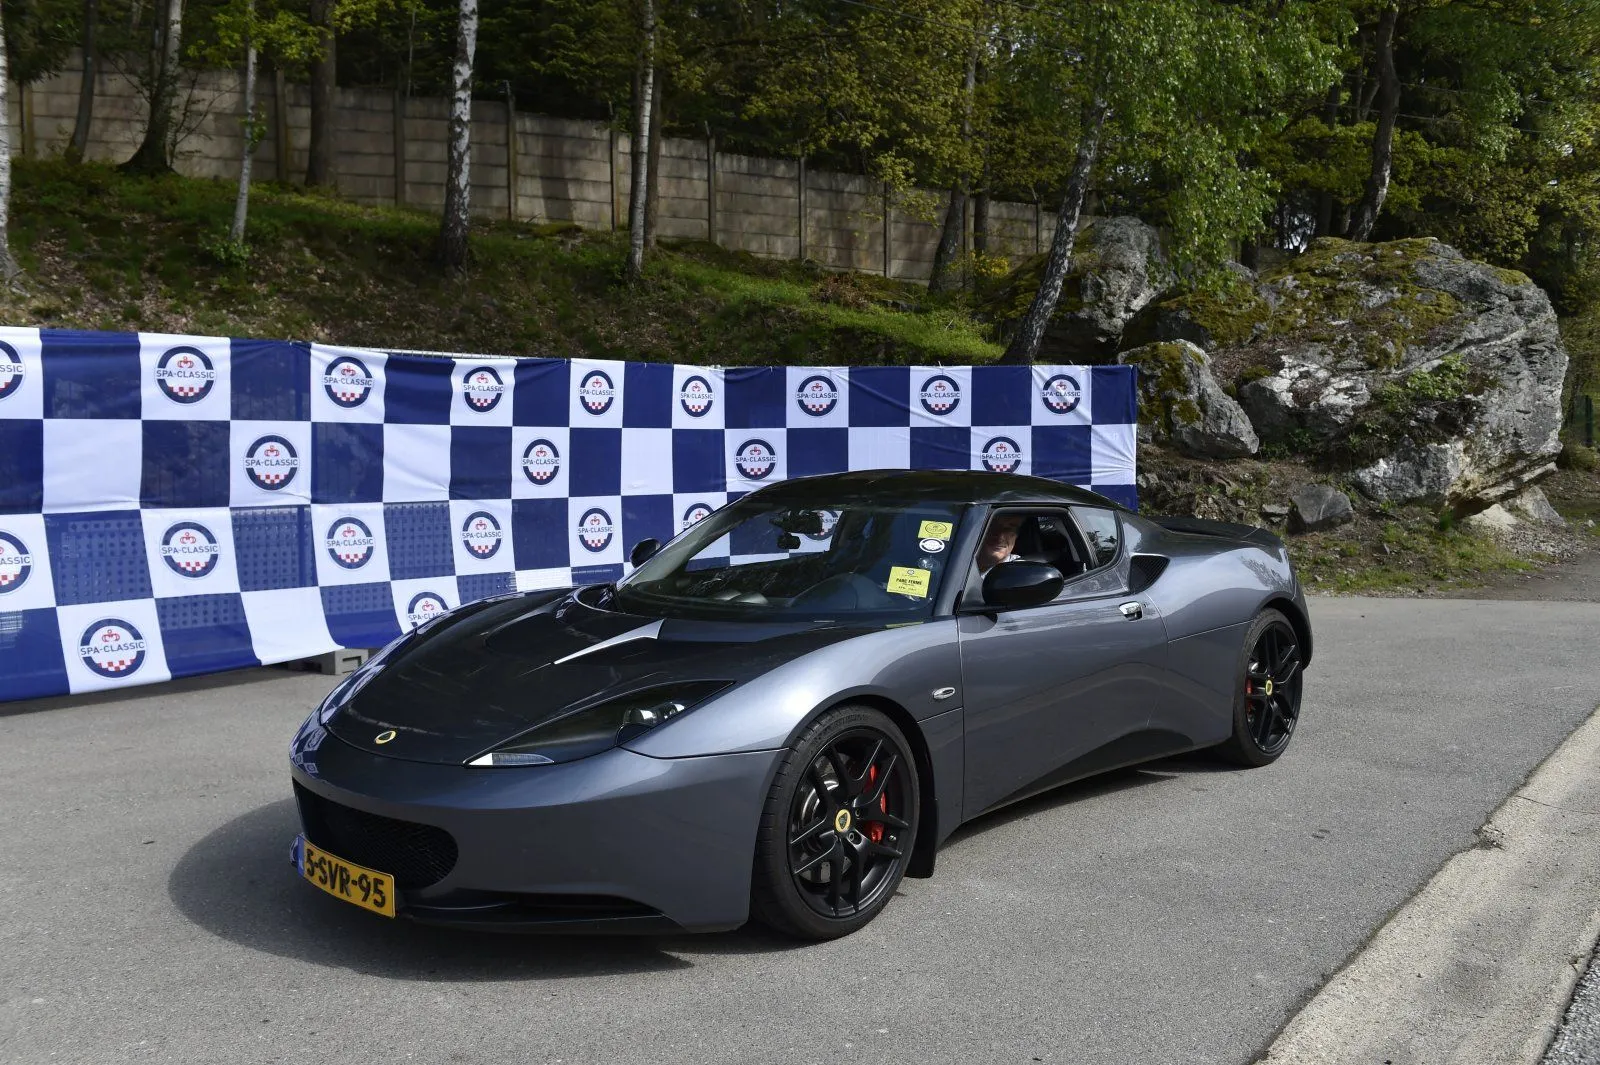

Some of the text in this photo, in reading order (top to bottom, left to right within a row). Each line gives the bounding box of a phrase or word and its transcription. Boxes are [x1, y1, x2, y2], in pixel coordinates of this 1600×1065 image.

[156, 370, 215, 380] SPA-CLASSIC
[324, 376, 372, 386] SPA-CLASSIC
[463, 384, 504, 392] SPA-CLASSIC
[580, 388, 614, 396] SPA-CLASSIC
[796, 392, 838, 400] SPA-CLASSIC
[736, 456, 776, 464] SPA-CLASSIC
[982, 453, 1022, 461] SPA-CLASSIC
[245, 458, 298, 467] SPA-CLASSIC
[522, 458, 560, 466] SPA-CLASSIC
[578, 526, 613, 534] SPA-CLASSIC
[462, 531, 502, 540] SPA-CLASSIC
[326, 538, 374, 548] SPA-CLASSIC
[161, 544, 218, 555] SPA-CLASSIC
[80, 640, 145, 656] SPA-CLASSIC
[306, 849, 386, 908] 5-SVR-95
